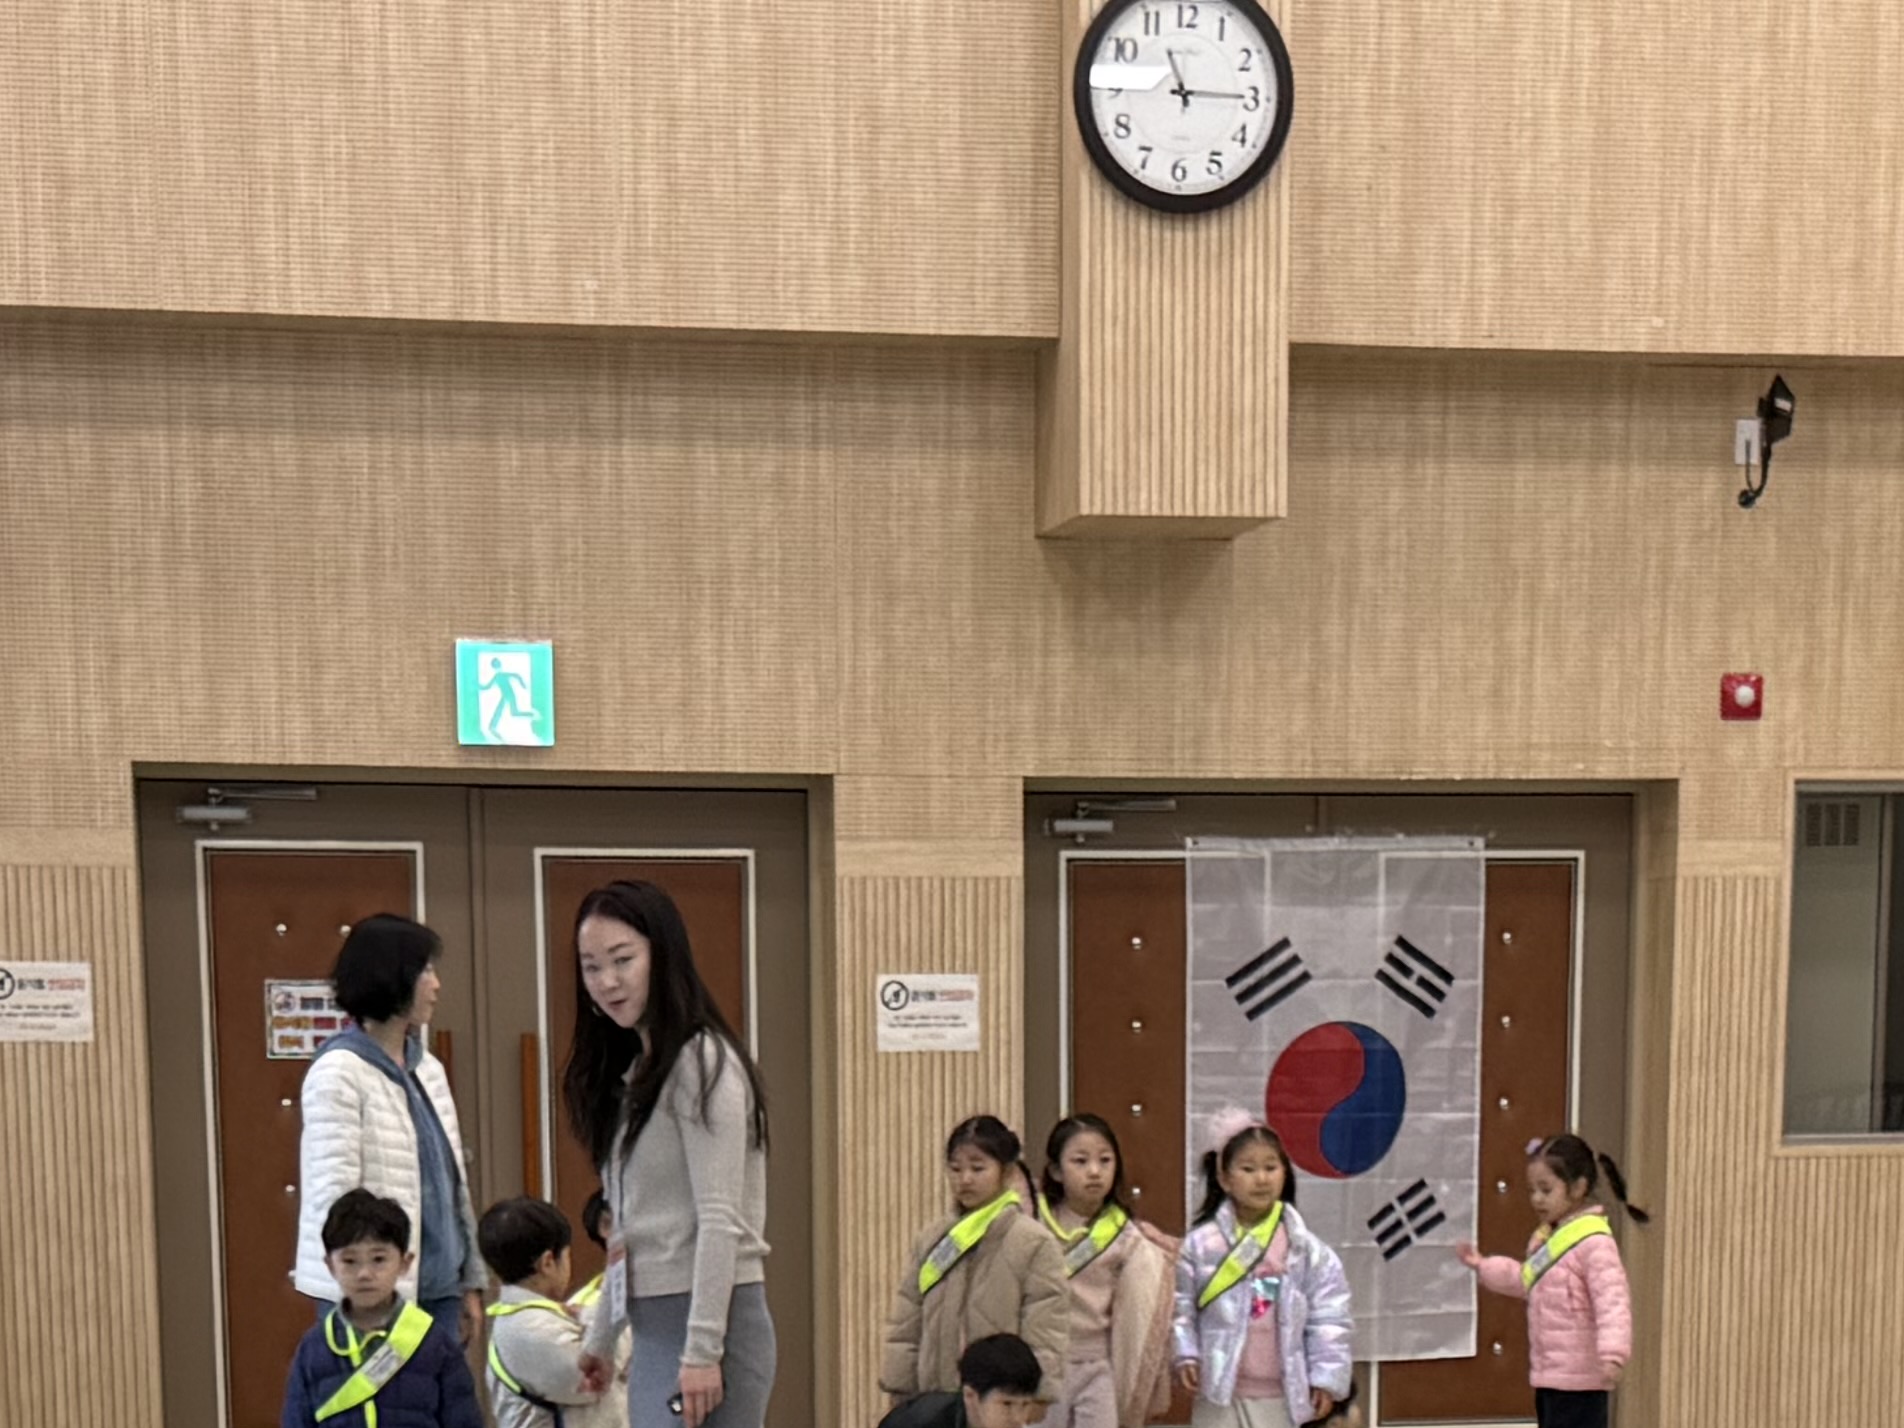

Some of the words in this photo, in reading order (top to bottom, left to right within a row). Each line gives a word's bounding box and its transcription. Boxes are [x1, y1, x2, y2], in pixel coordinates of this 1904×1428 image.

[1144, 10, 1160, 36] 11
[1177, 3, 1199, 29] 12
[1218, 15, 1225, 42] 1
[1112, 37, 1138, 63] 10
[1237, 48, 1252, 72] 2
[1243, 86, 1260, 112] 3
[1113, 113, 1131, 139] 8
[1231, 123, 1247, 148] 4
[1138, 145, 1153, 170] 7
[1171, 157, 1187, 182] 6
[1206, 151, 1223, 176] 5
